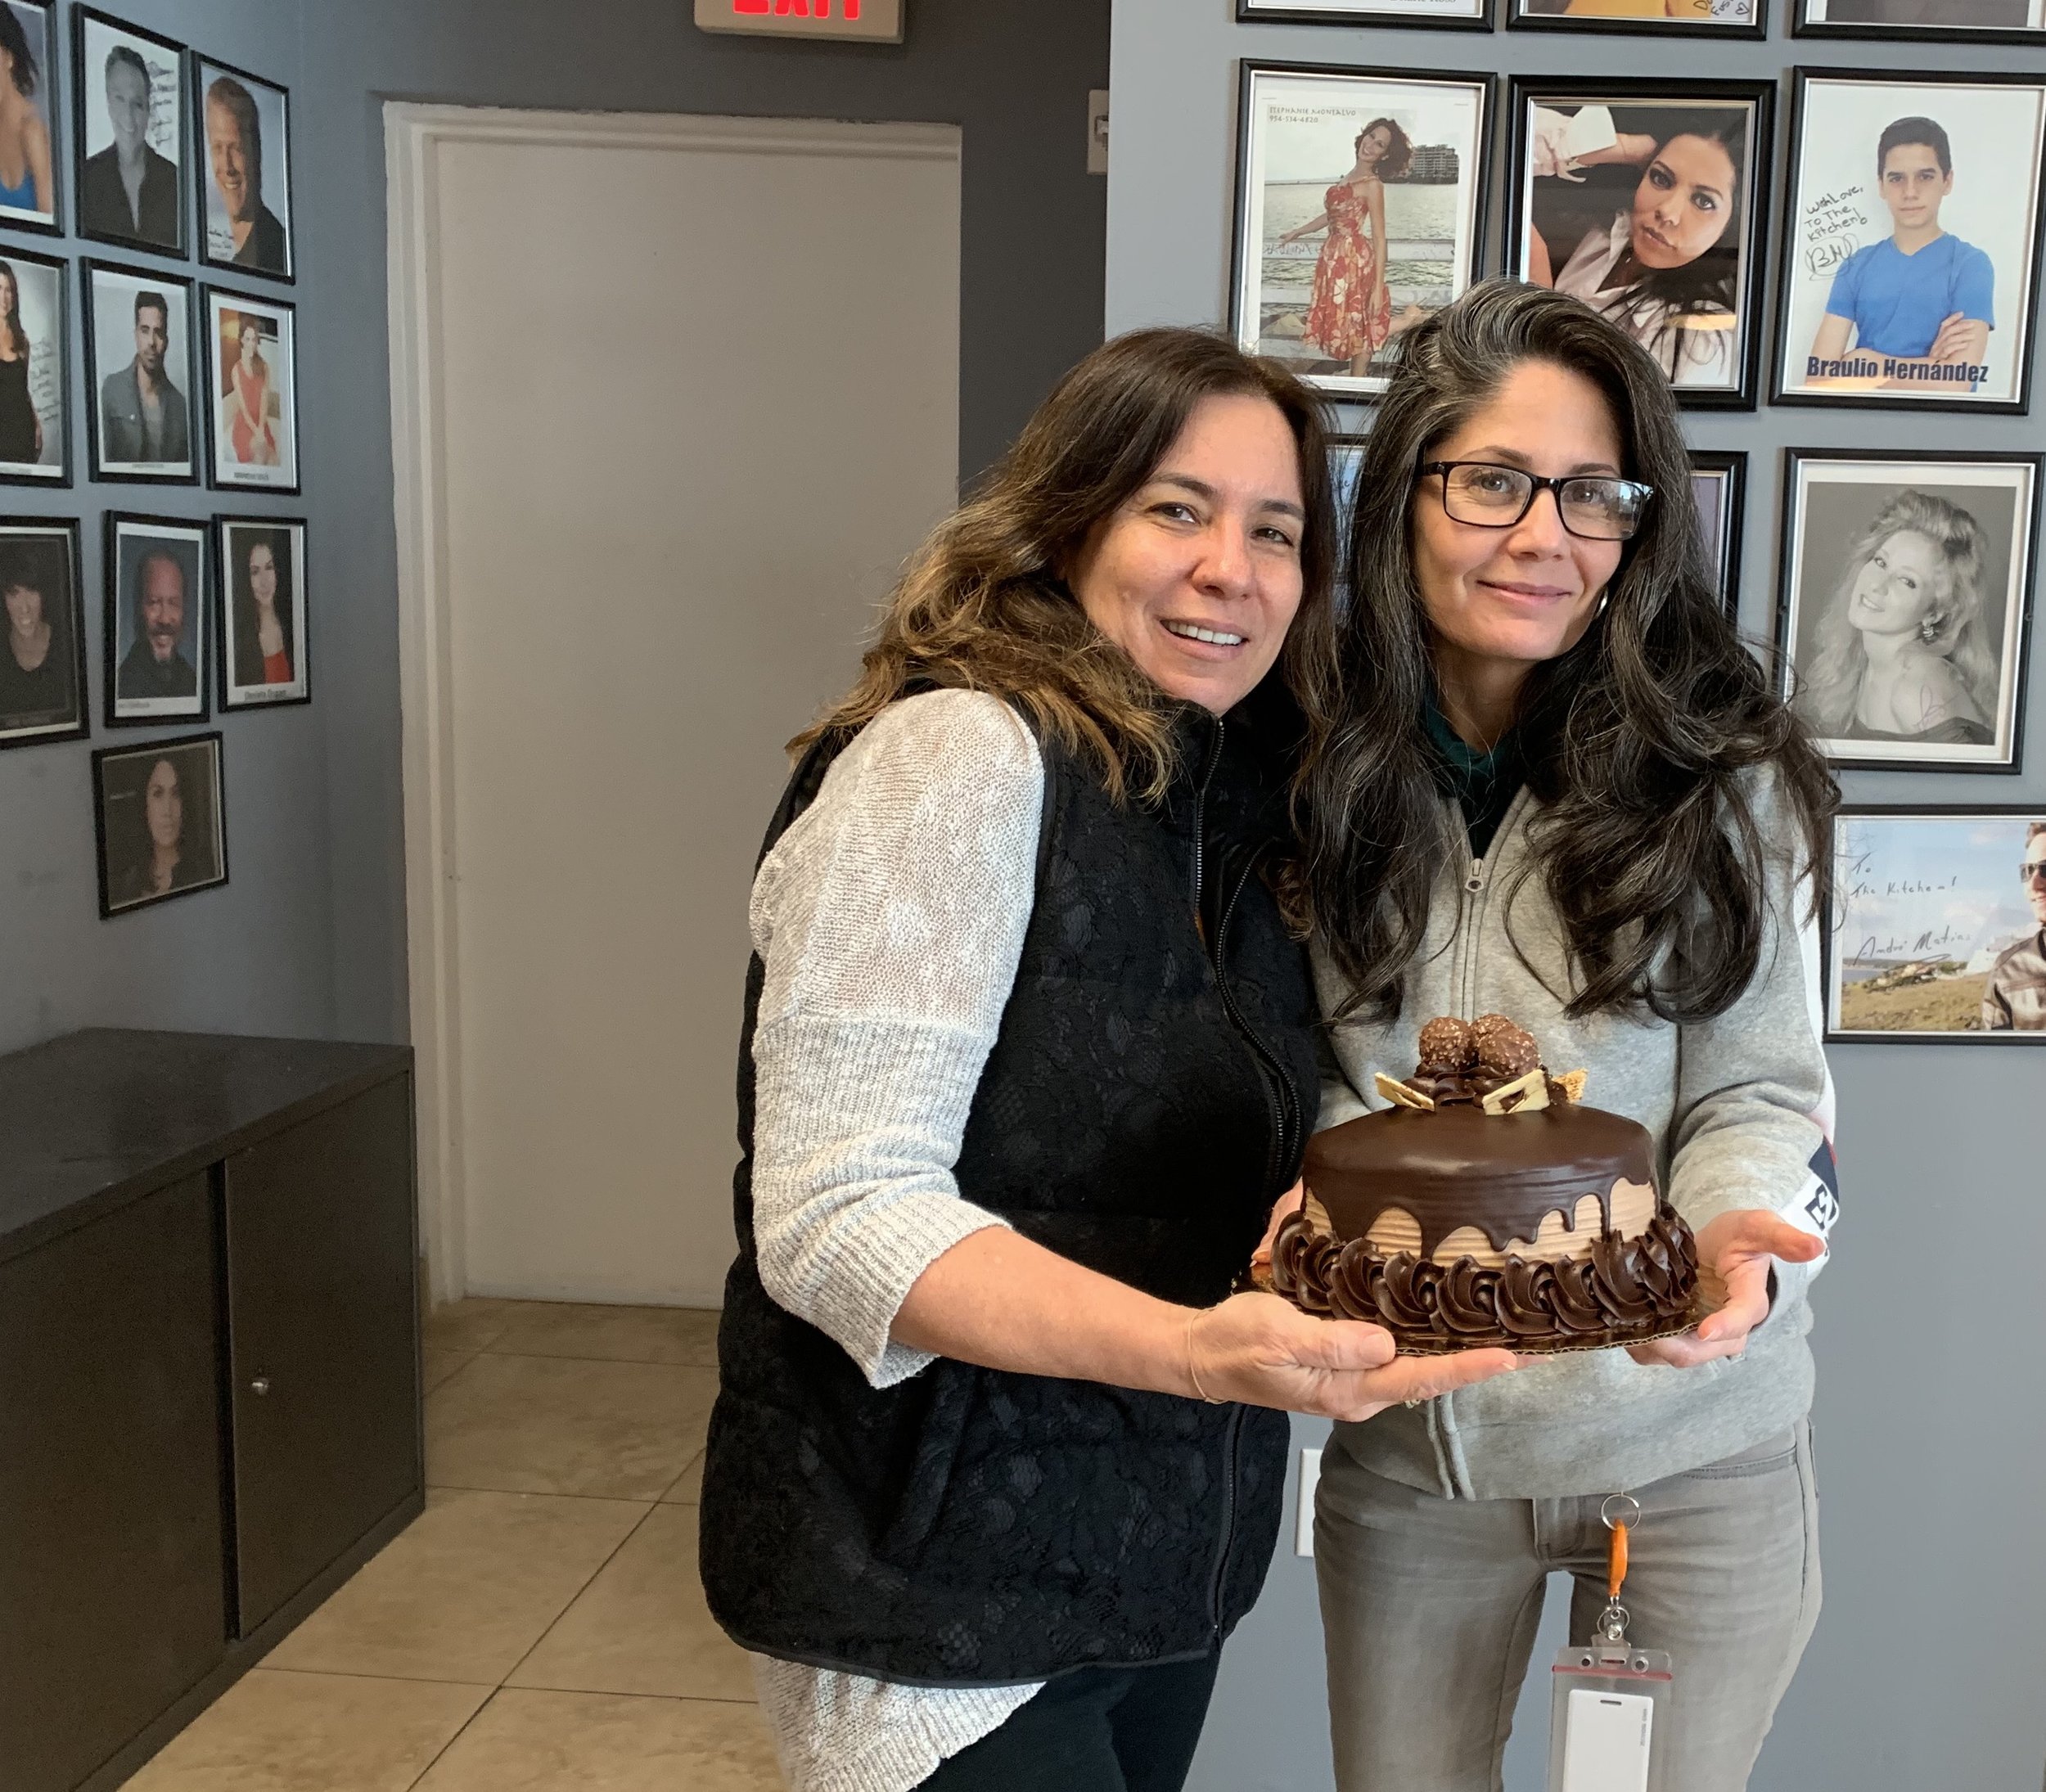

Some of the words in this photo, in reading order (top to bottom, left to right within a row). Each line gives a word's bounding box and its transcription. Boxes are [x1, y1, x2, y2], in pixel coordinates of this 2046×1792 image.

[1269, 106, 1309, 114] STEPHANIE
[1804, 218, 1822, 227] To
[1822, 205, 1851, 220] The
[1806, 356, 1878, 378] Braulio
[1883, 358, 1989, 383] Hernández
[1851, 852, 1872, 875] To
[1850, 881, 1876, 898] The
